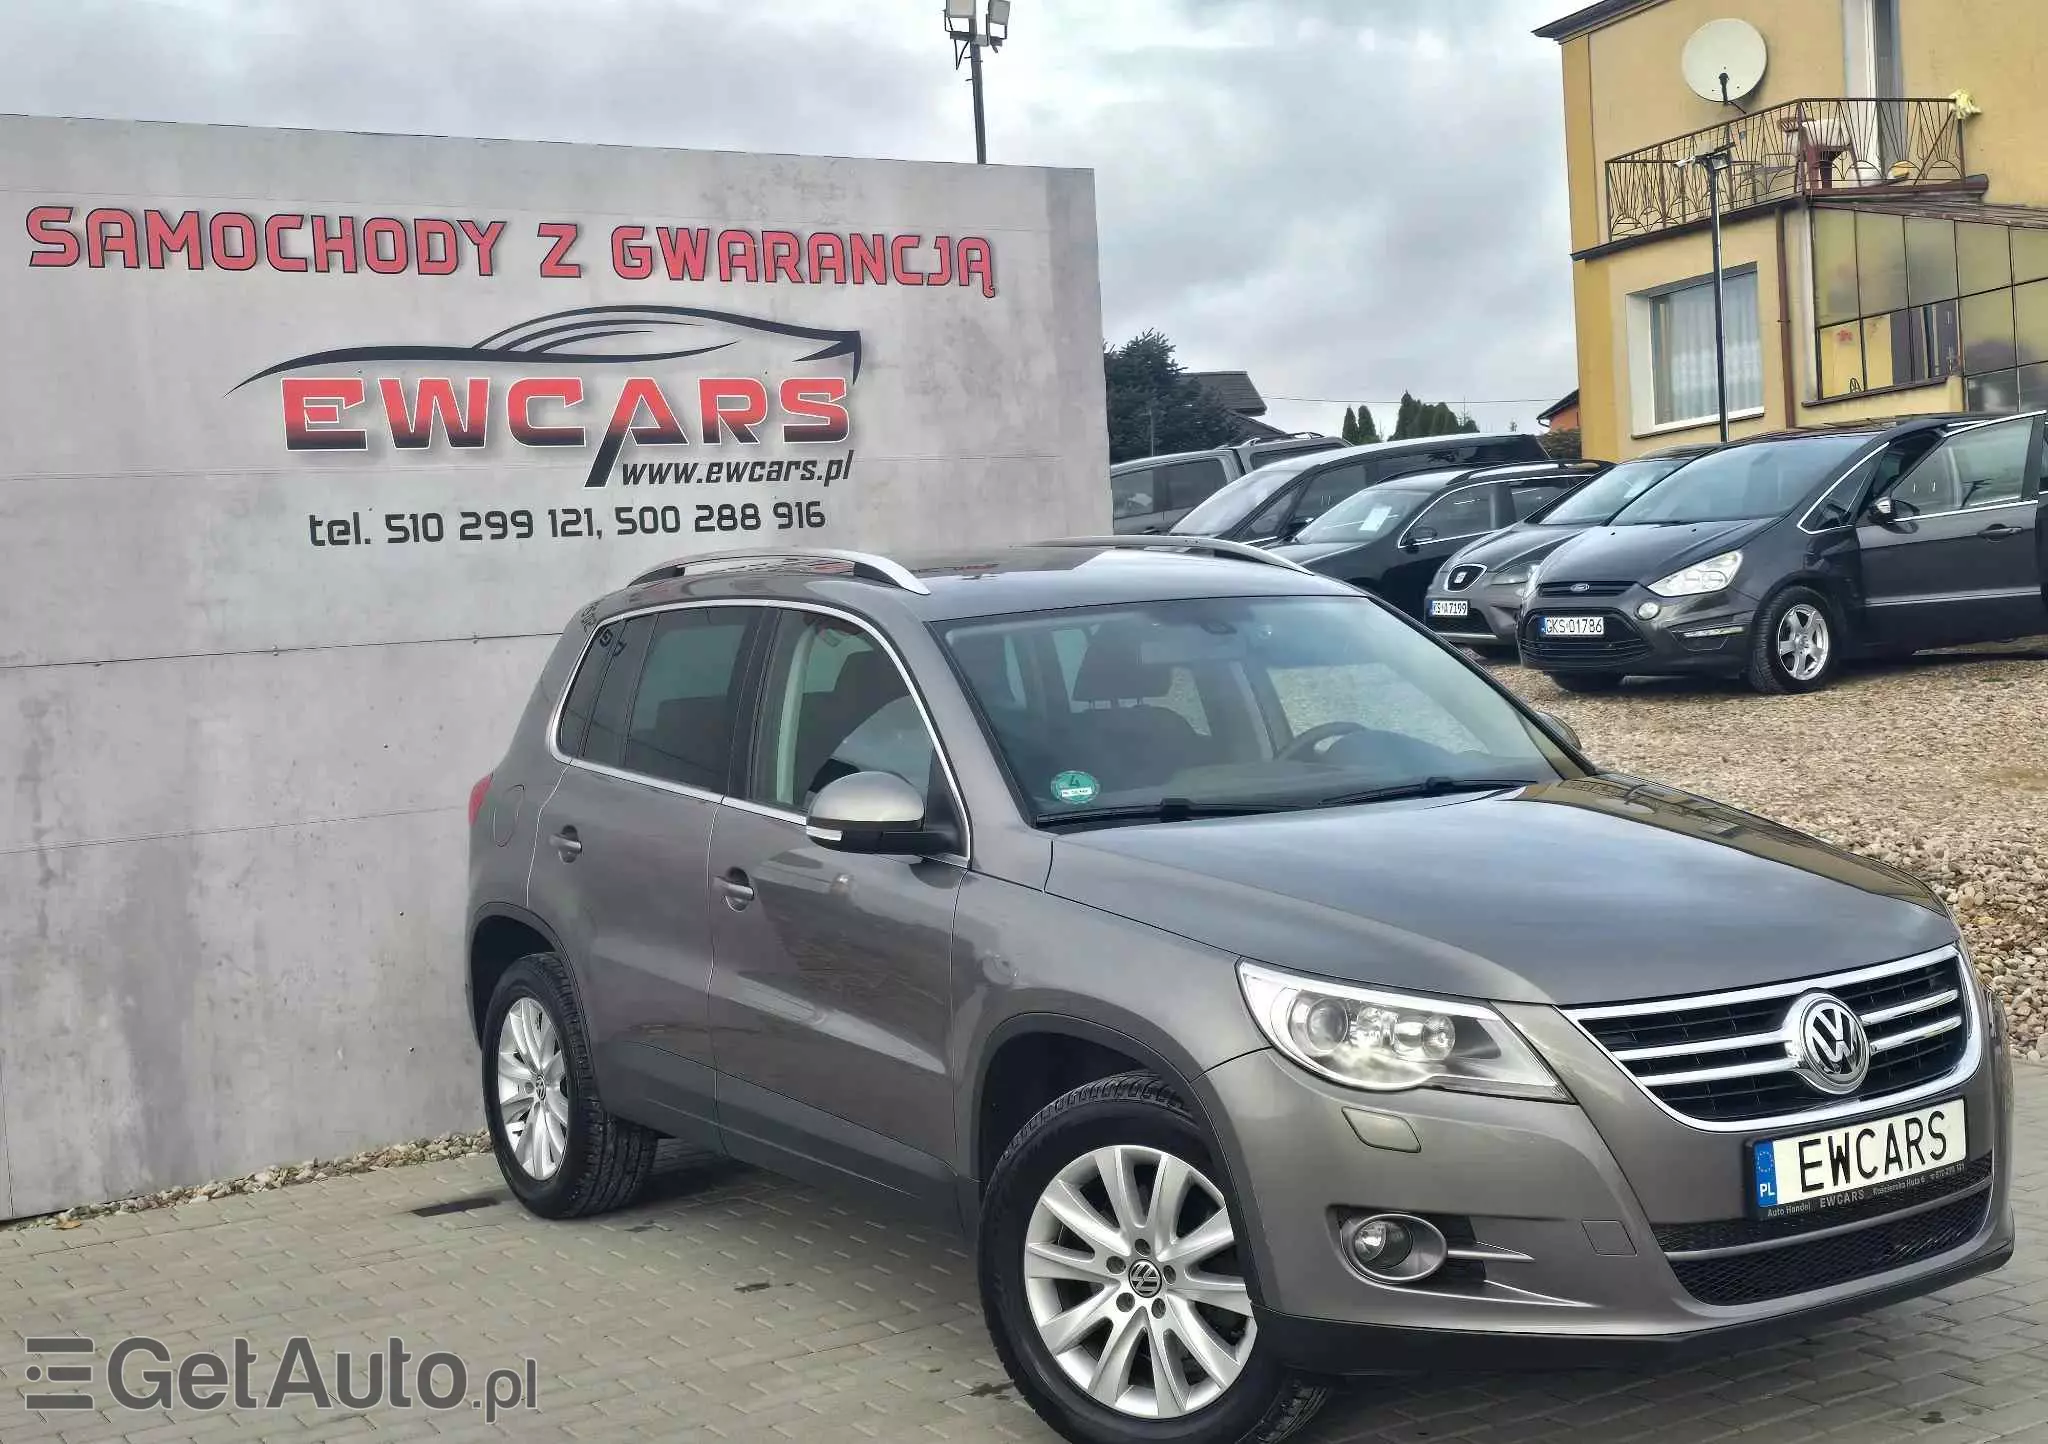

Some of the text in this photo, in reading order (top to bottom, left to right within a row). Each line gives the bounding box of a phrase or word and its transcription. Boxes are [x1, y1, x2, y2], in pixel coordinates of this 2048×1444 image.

[26, 205, 996, 298] SAMOCHODY Z GWARANCJĄ
[280, 376, 851, 488] EWCARS
[621, 449, 855, 487] www.ewcars.pl
[309, 500, 827, 546] tel. 510 299 121, 500 288 916
[1798, 1109, 1948, 1193] EWCARS
[1759, 1182, 1776, 1198] PL
[1767, 1207, 1785, 1217] Auto
[1820, 1189, 1865, 1208] EWCARS
